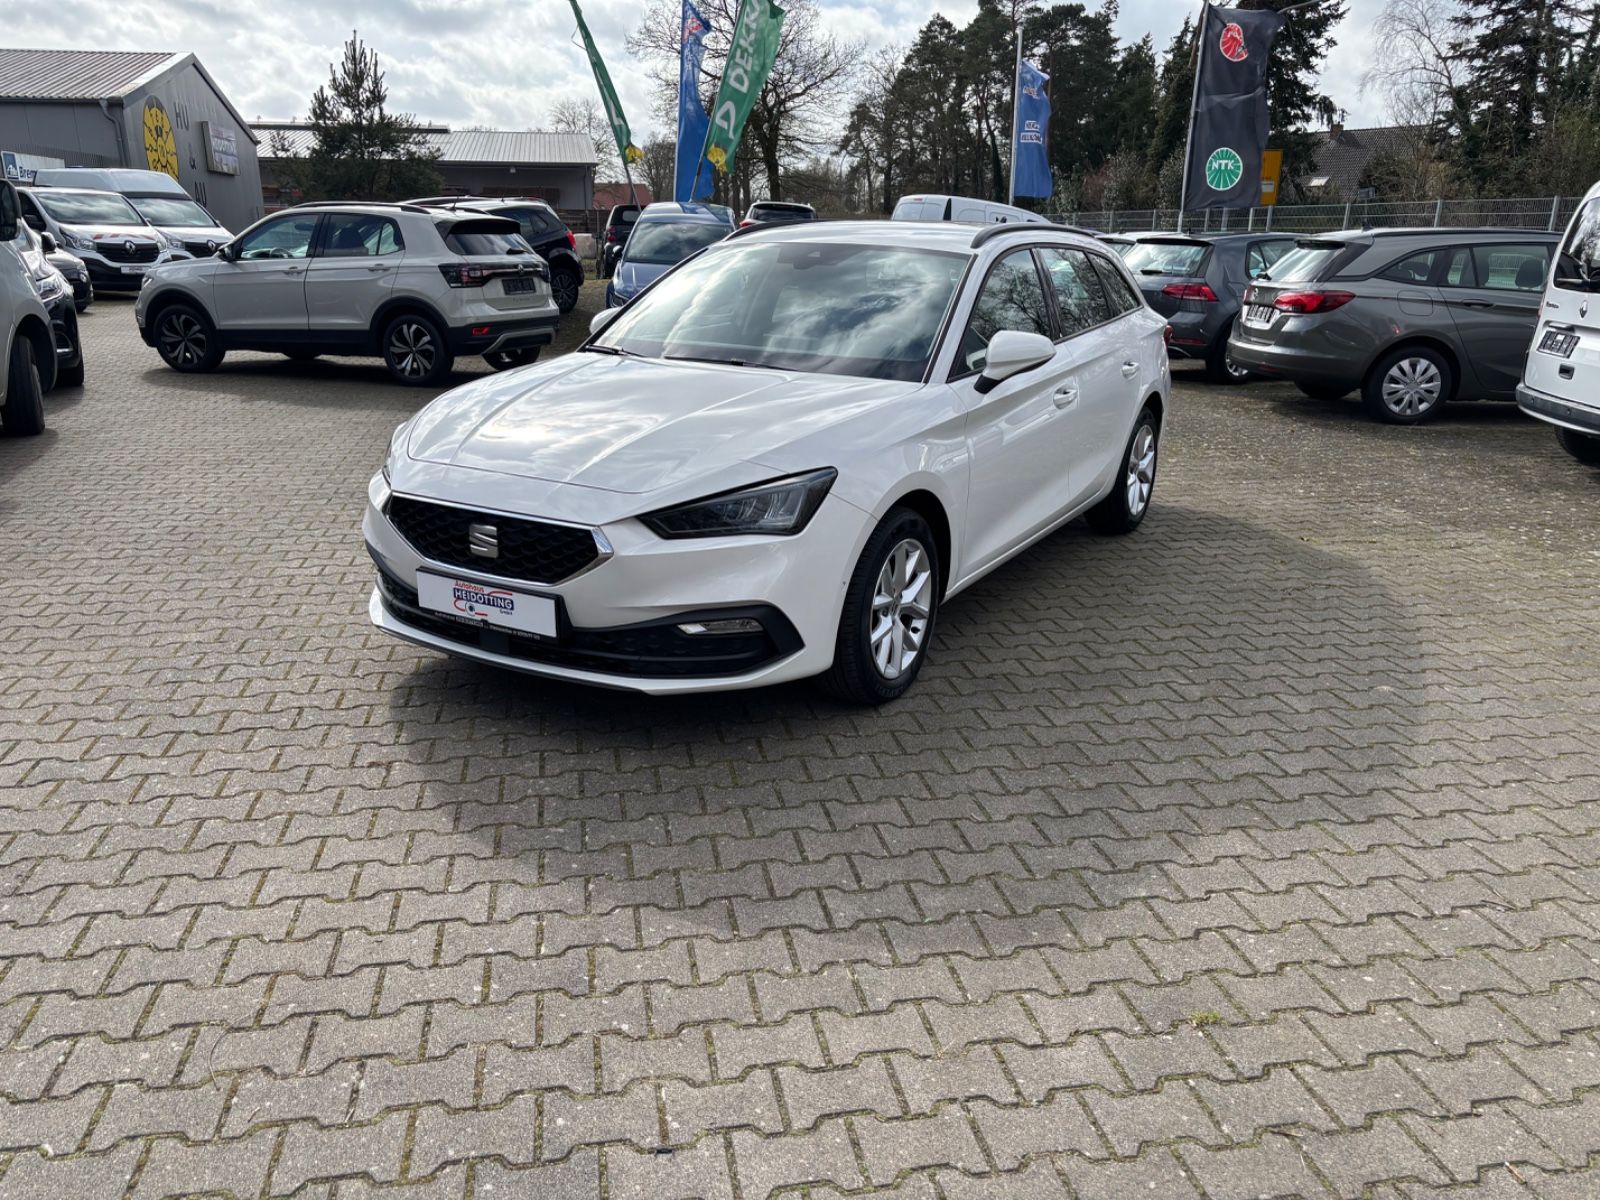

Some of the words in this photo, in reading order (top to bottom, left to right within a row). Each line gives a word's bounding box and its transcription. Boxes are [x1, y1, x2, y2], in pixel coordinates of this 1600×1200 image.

[174, 102, 190, 131] HU
[212, 159, 234, 170] NTK
[194, 181, 207, 207] AU
[455, 580, 485, 593] Autohaus
[455, 589, 513, 609] HEIDOTTING
